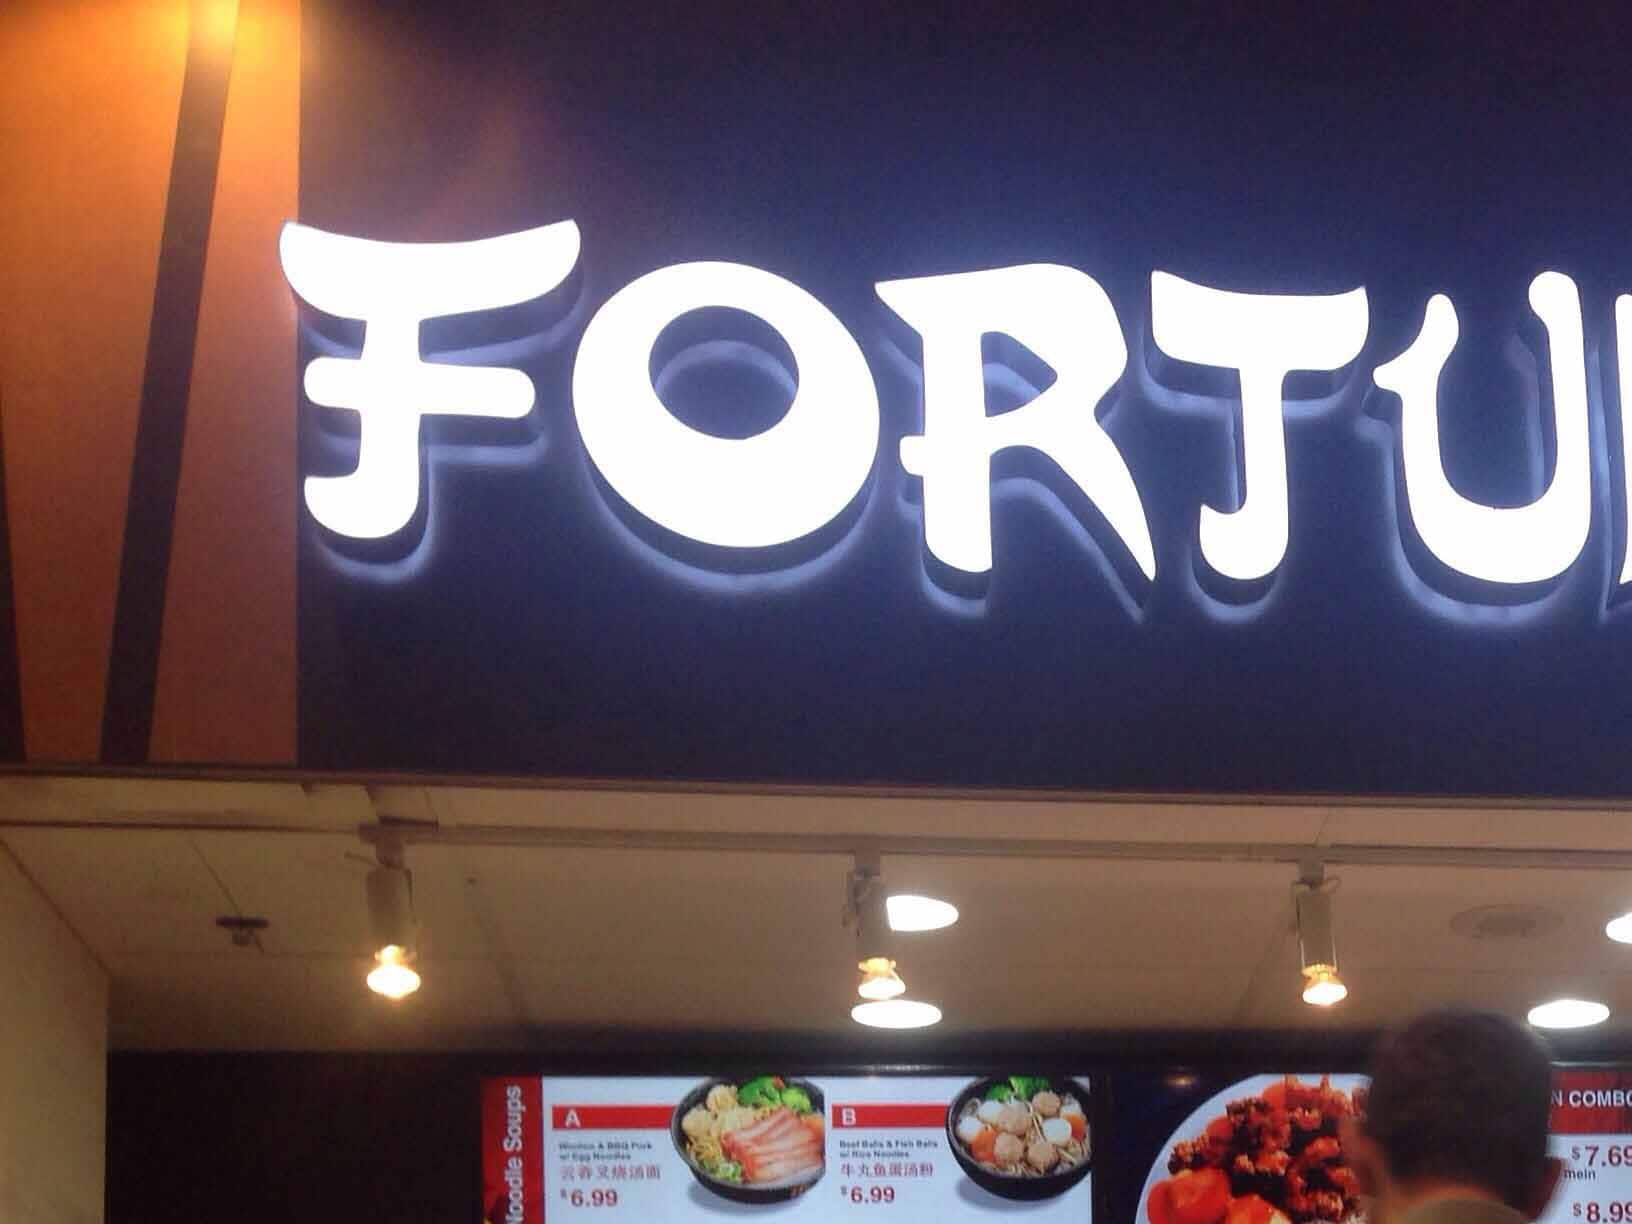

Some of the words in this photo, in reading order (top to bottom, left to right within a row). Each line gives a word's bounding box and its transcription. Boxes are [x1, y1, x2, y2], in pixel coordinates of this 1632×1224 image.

[503, 1085, 526, 1151] Soups
[565, 1108, 581, 1127] A
[841, 1106, 857, 1126] B
